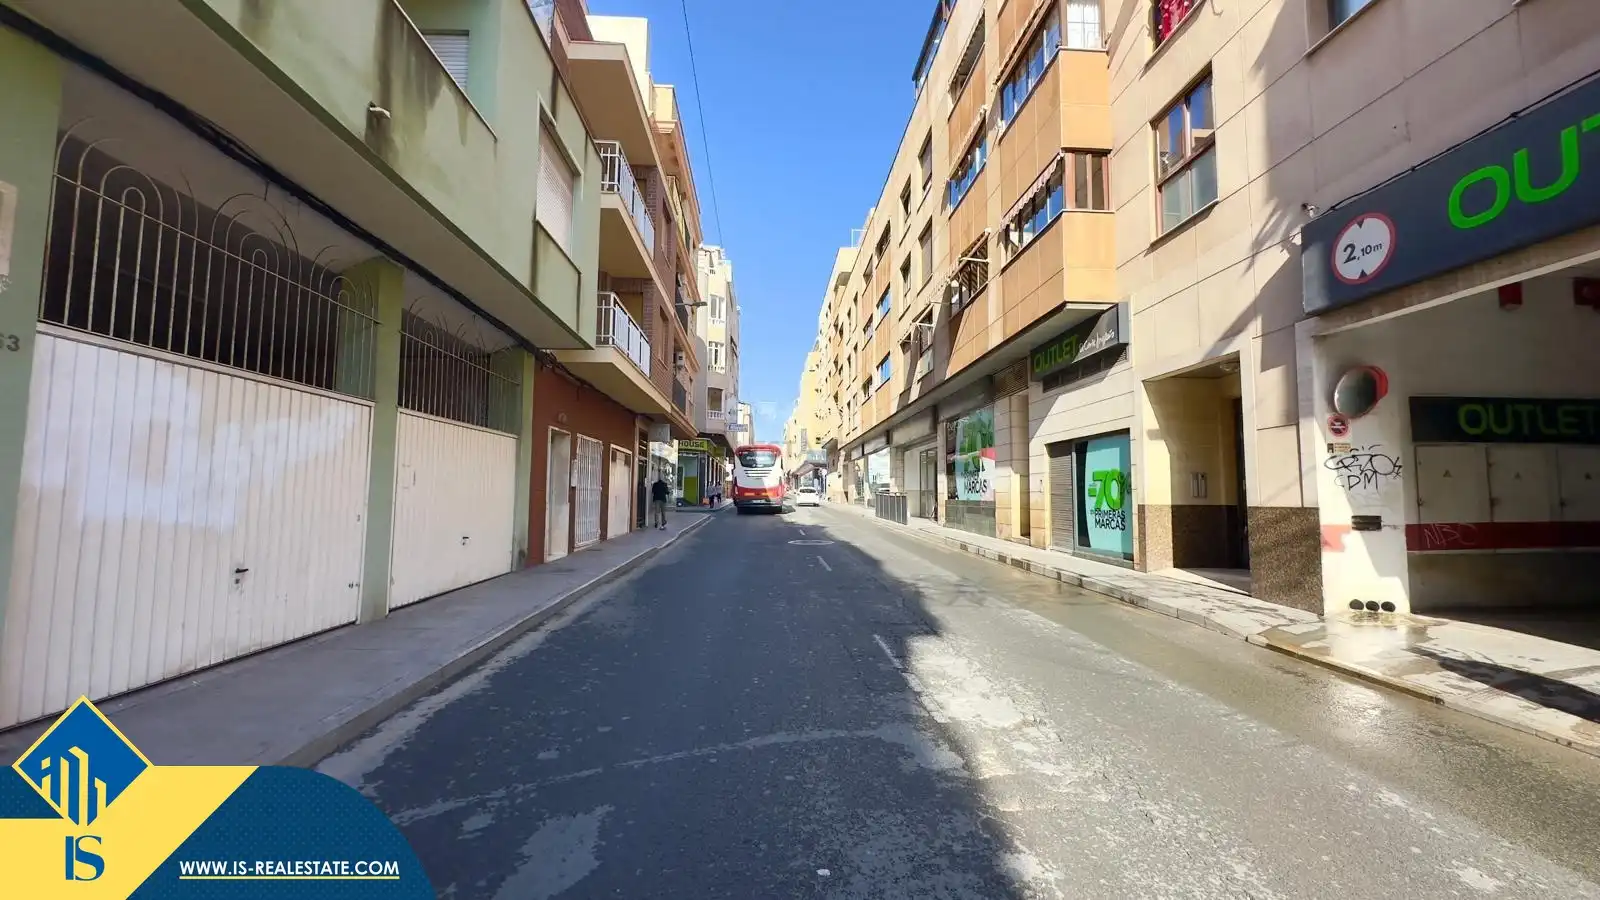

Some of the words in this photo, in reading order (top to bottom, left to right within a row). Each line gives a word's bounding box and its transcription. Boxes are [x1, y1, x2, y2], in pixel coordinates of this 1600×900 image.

[1034, 334, 1079, 372] OUTLET
[1457, 403, 1598, 436] OUTLET
[679, 440, 704, 448] HOUSE
[964, 479, 988, 495] MARCAS
[1095, 508, 1126, 520] PRIMERAS
[1095, 518, 1126, 531] MARCAS
